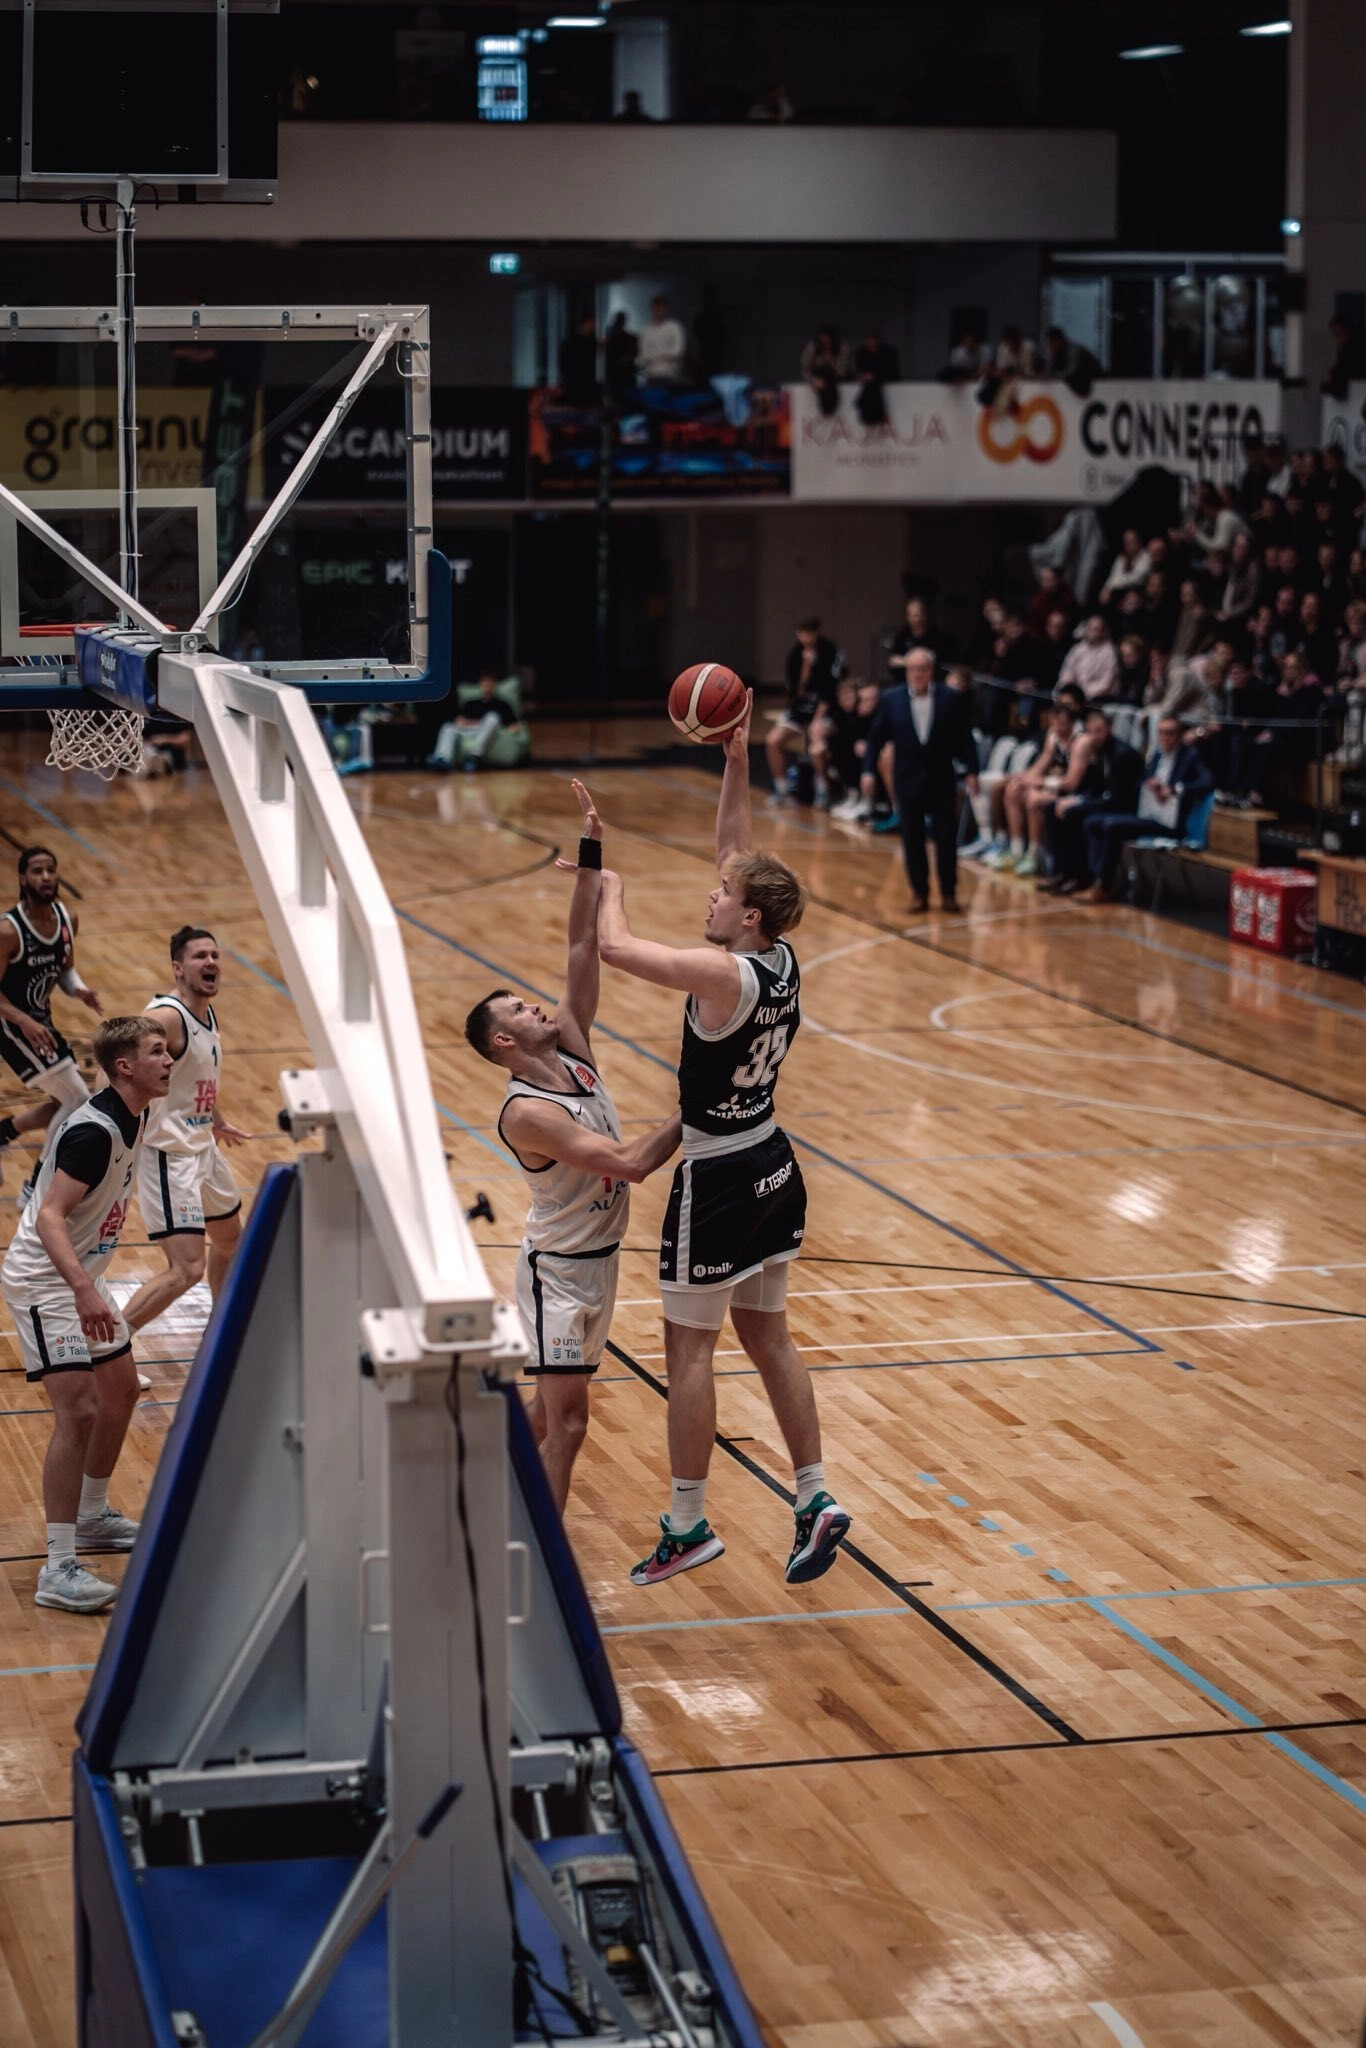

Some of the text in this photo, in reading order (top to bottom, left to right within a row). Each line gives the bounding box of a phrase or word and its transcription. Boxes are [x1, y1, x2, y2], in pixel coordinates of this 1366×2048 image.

[1080, 401, 1262, 461] CONNECTO
[301, 558, 474, 585] EPIC KT
[732, 1024, 789, 1089] 32
[194, 1096, 216, 1113] TE
[122, 1161, 133, 1188] 5
